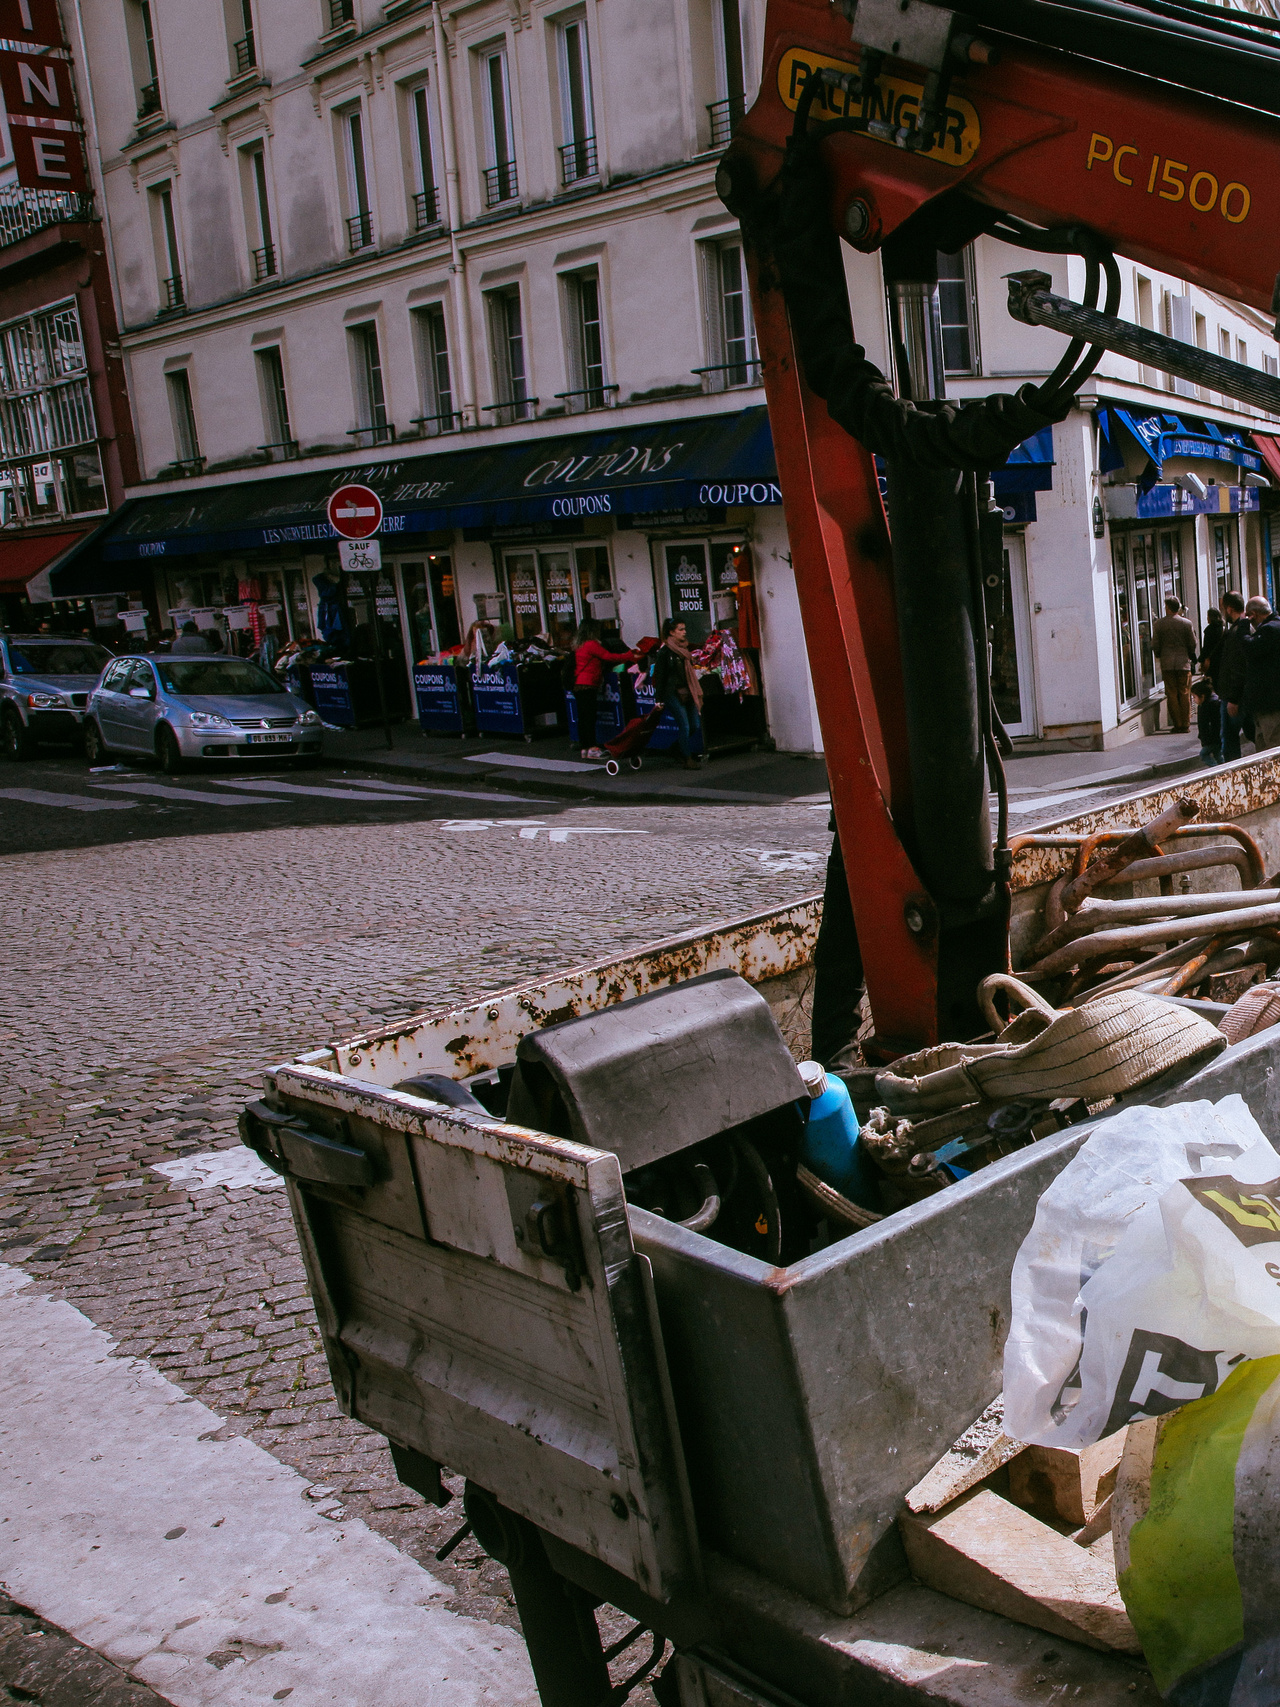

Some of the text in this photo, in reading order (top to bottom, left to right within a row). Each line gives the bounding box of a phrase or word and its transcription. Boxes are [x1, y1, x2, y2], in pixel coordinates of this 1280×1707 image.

[1086, 130, 1252, 225] PC 1500
[523, 442, 686, 488] COUPONS
[700, 482, 784, 505] COUPON
[552, 494, 612, 517] COUPONS
[263, 528, 281, 545] LES
[279, 521, 330, 543] MERVEILLES
[348, 543, 371, 552] SAUF
[675, 573, 702, 582] COUPONS
[679, 587, 700, 599] TULLE
[515, 604, 538, 614] COTON
[679, 598, 704, 612] BRODÉ
[311, 672, 338, 683] COUPONS
[414, 674, 444, 685] COUPONS
